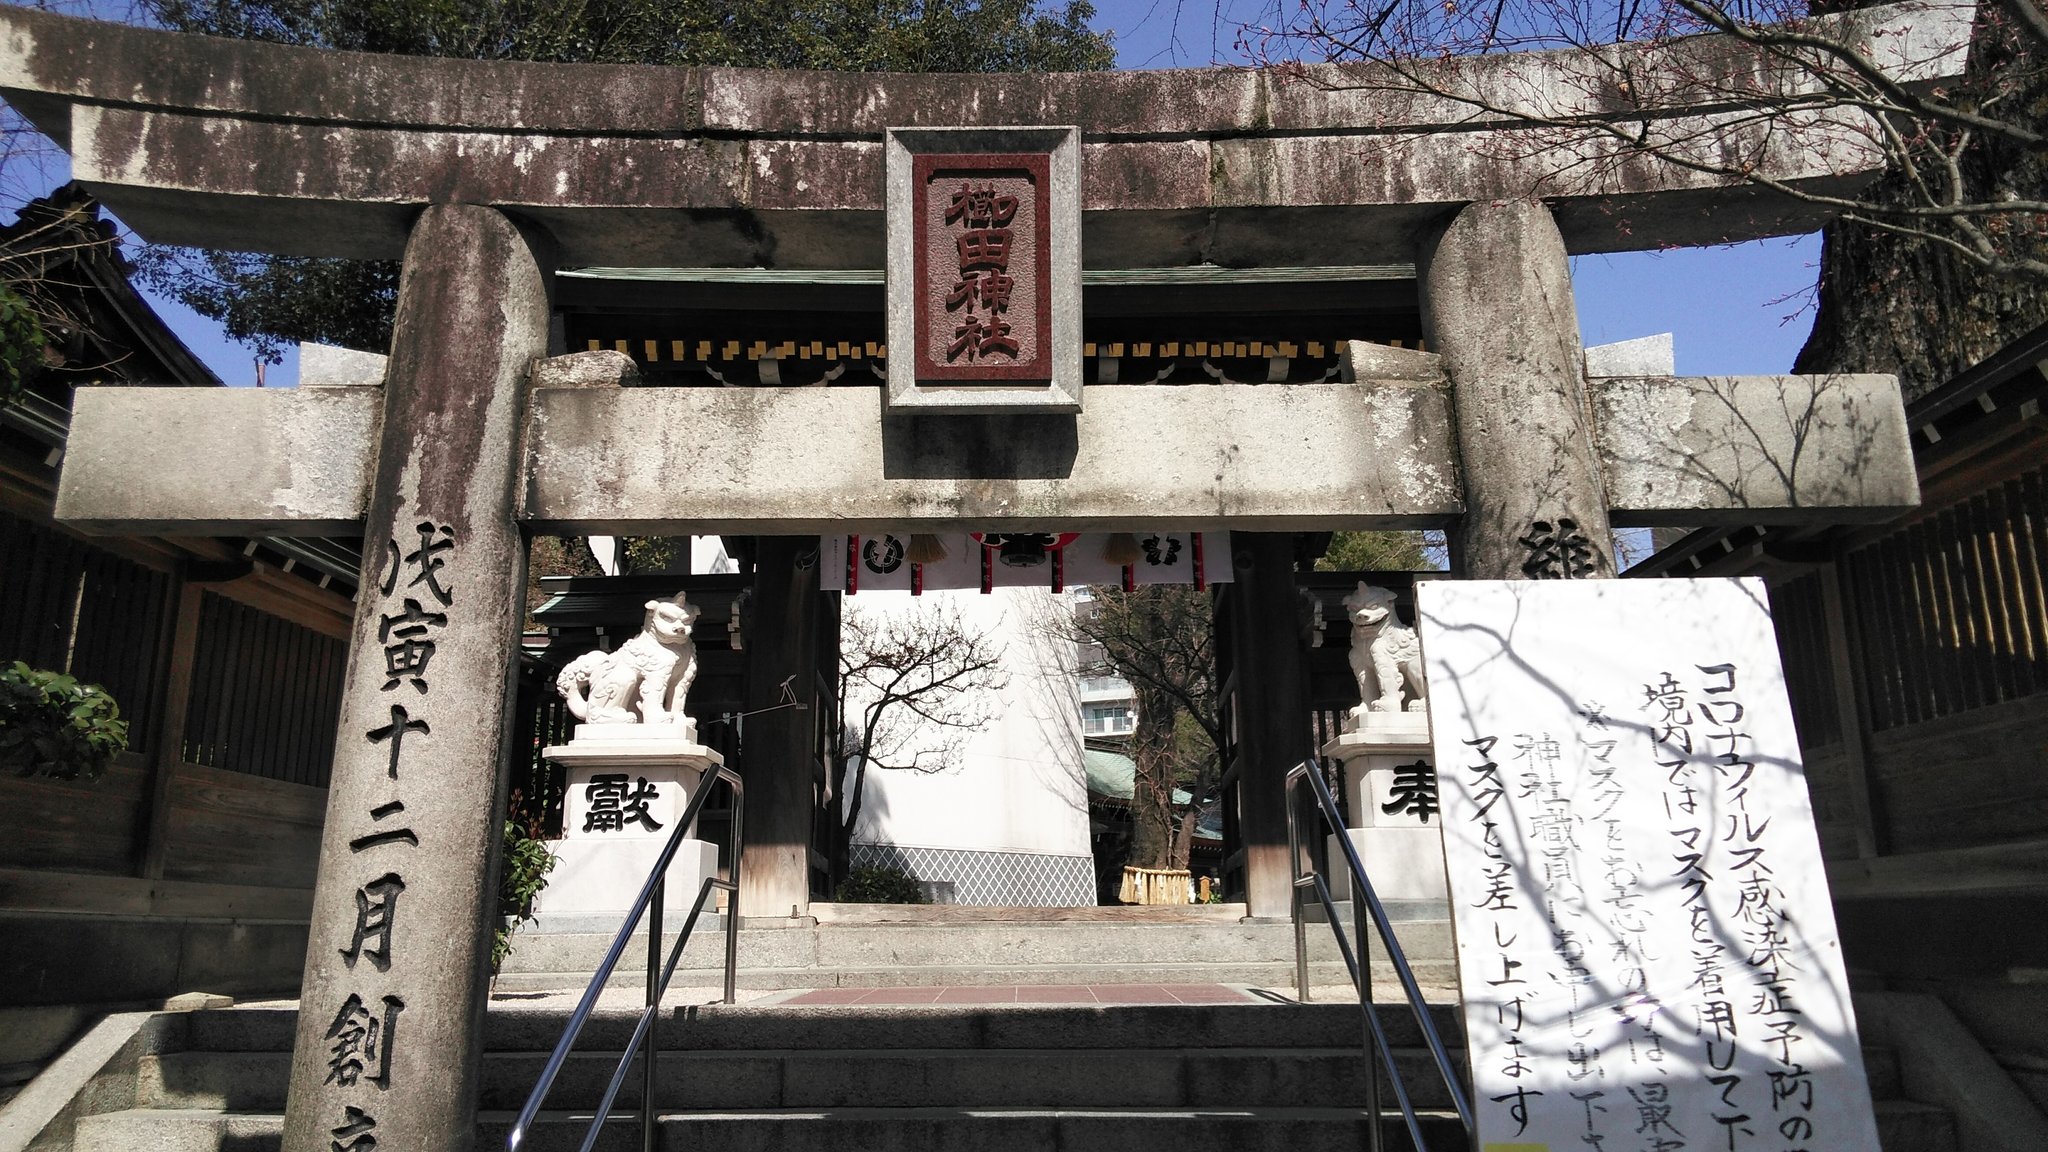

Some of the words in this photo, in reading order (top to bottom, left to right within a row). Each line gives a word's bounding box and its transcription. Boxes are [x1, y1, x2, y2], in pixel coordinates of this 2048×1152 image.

[945, 182, 1020, 363] 櫛田神社
[1460, 734, 1543, 1138] マスクを差し上げます
[1694, 663, 1814, 1152] コロナウィルス感染症予防の
